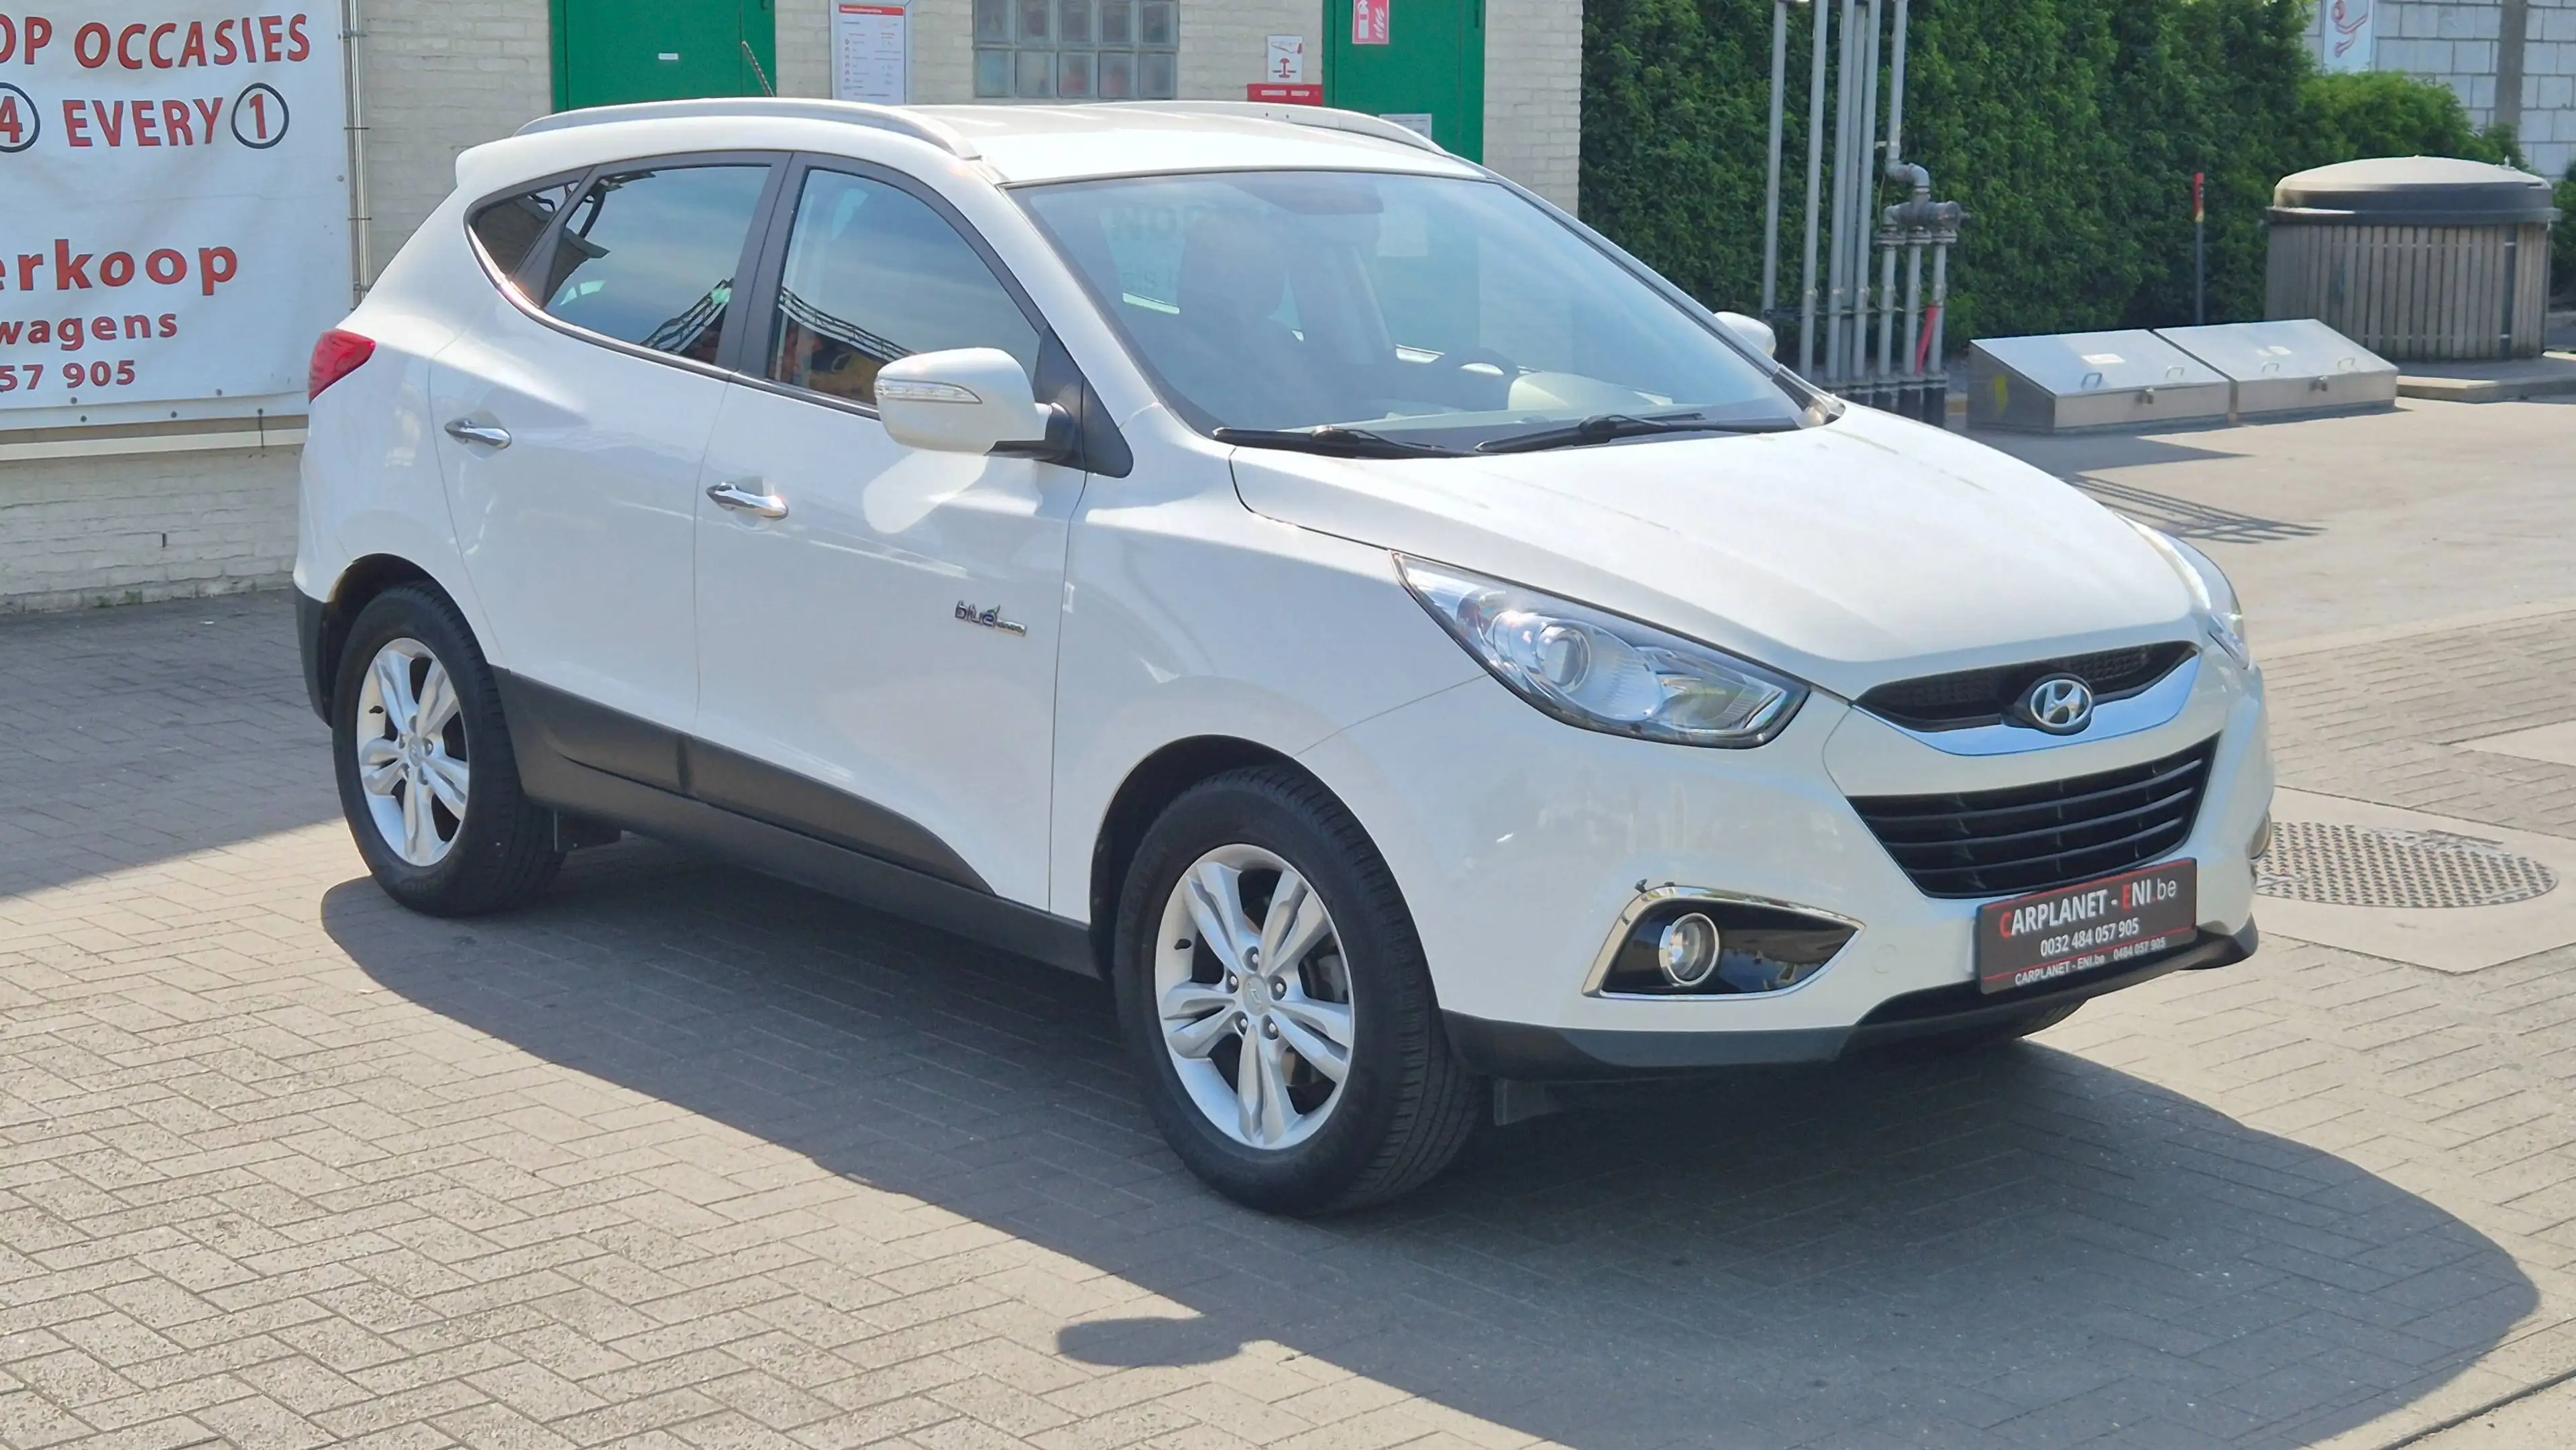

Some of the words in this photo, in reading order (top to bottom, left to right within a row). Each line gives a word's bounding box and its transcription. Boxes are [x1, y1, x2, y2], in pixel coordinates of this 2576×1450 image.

[74, 13, 310, 69] OCCASIES
[62, 97, 223, 147] EVERY
[249, 93, 267, 139] 1
[0, 238, 238, 296] rkoop
[62, 360, 136, 389] 905
[2000, 888, 2108, 937] CARPLANET
[2123, 878, 2176, 910] ENI.be
[2015, 960, 2071, 986] CARPLANET
[2113, 944, 2133, 961] 0484
[2134, 940, 2149, 955] 057
[2151, 936, 2166, 951] 905
[2041, 935, 2070, 957] 0032
[2072, 928, 2093, 949] 484
[2095, 923, 2116, 943] 057
[2118, 917, 2139, 937] 905
